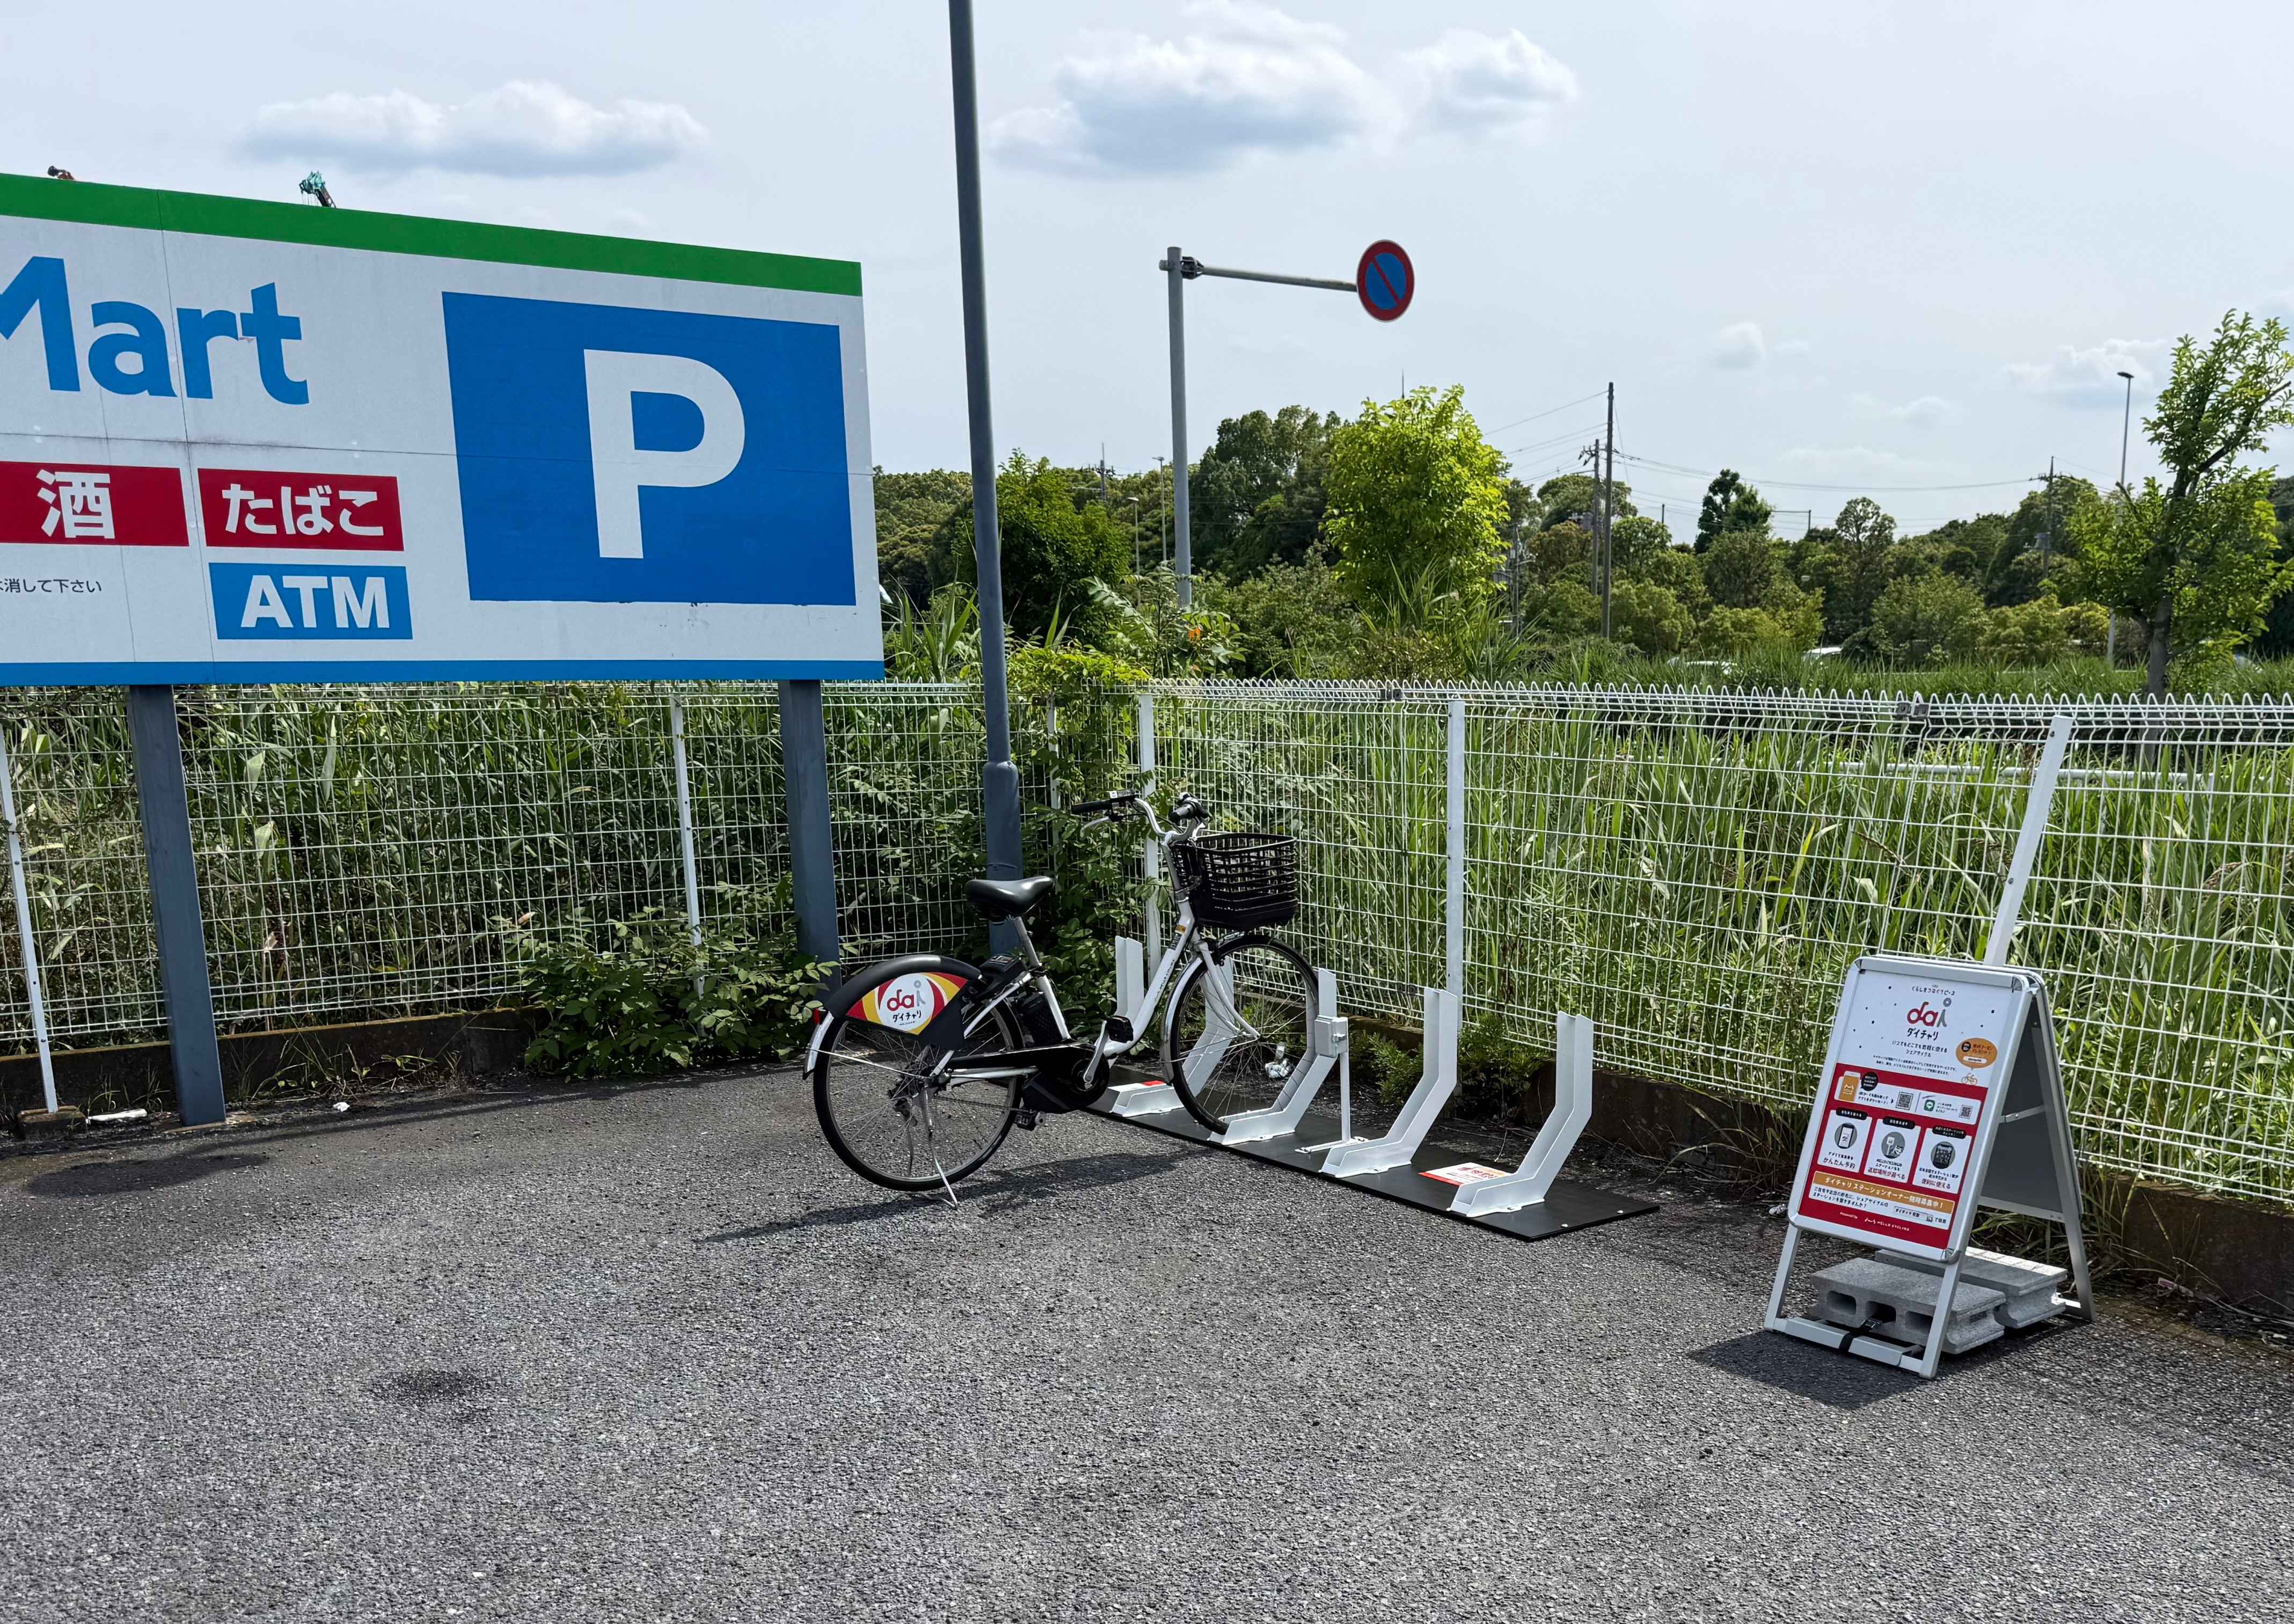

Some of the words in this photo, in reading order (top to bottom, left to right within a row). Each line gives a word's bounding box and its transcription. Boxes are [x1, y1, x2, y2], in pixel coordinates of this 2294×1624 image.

[584, 349, 745, 559] P
[36, 469, 115, 539] 酒
[221, 482, 385, 537] たばこ
[240, 575, 390, 629] ATM
[887, 980, 926, 1011] dai
[893, 1010, 922, 1022] ダイチャリ
[1907, 998, 1952, 1027] dai
[1907, 1028, 1939, 1041] ダイチャリ
